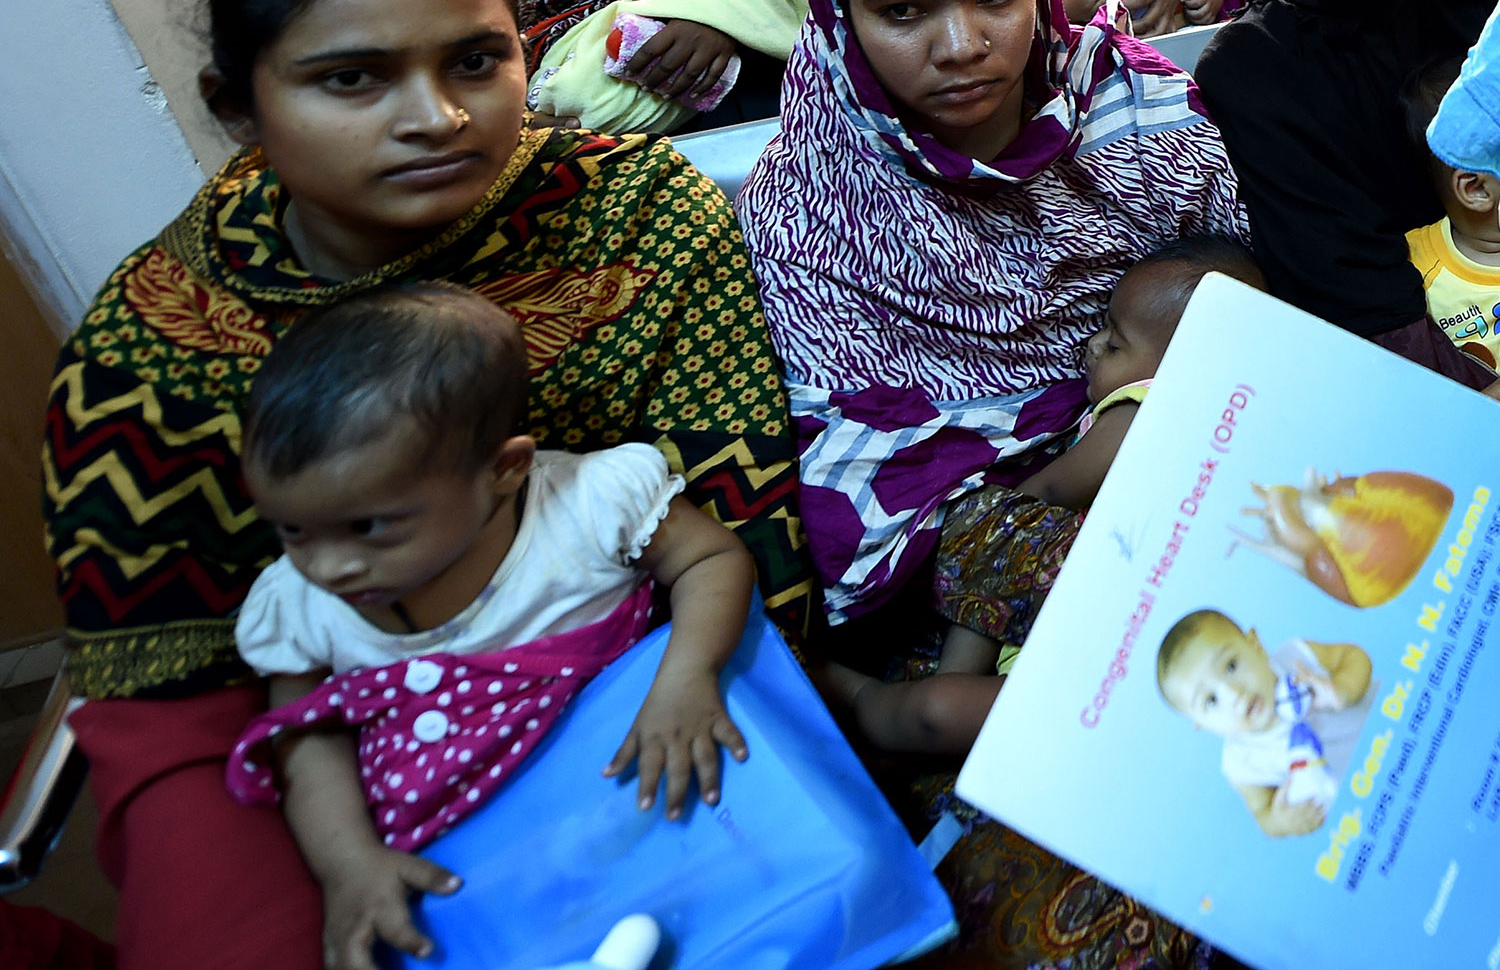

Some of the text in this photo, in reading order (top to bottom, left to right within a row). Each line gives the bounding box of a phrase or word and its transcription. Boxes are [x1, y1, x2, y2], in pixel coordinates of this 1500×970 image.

[1077, 381, 1257, 732] Congenital Heart Desk (OPD)
[1314, 483, 1492, 885] Brig. Gen. Dr. N. N. Fatema
